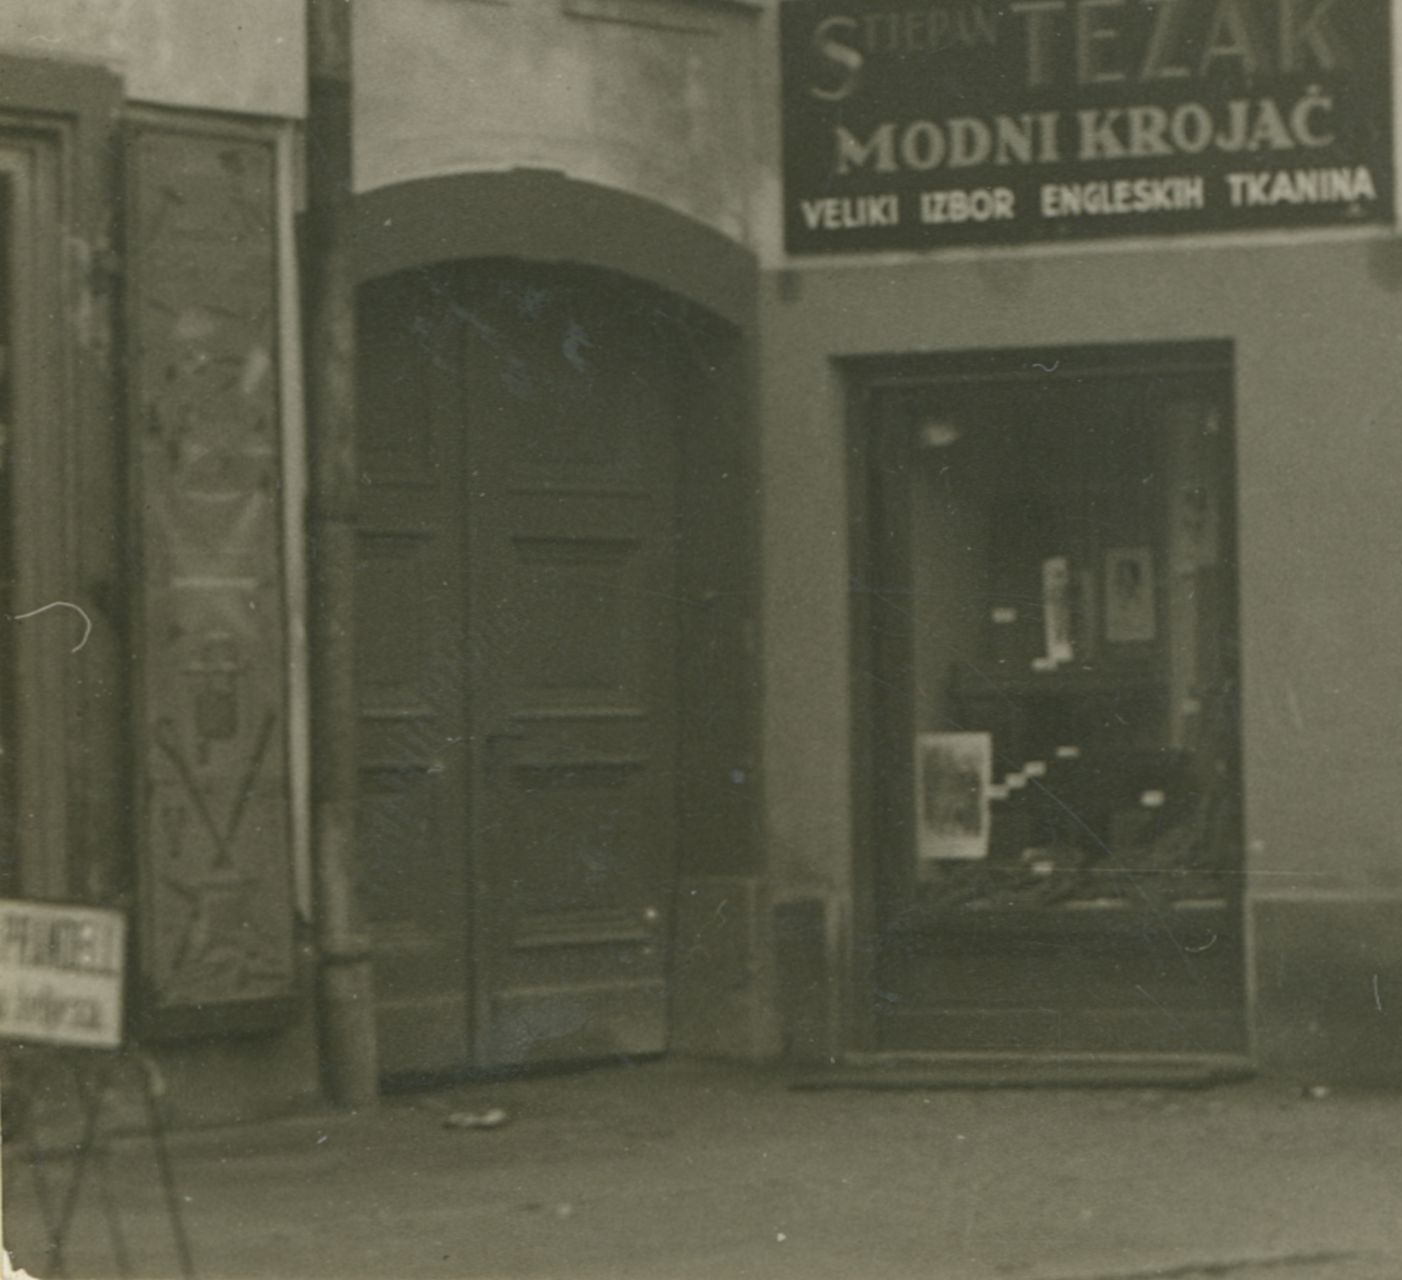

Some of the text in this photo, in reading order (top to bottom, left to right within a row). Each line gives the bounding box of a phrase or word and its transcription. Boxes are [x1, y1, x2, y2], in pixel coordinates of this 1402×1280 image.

[836, 84, 1336, 174] MODNI KROJAČ
[803, 165, 1377, 230] VELIKI IZBOR ENGLESKIH TKANINA
